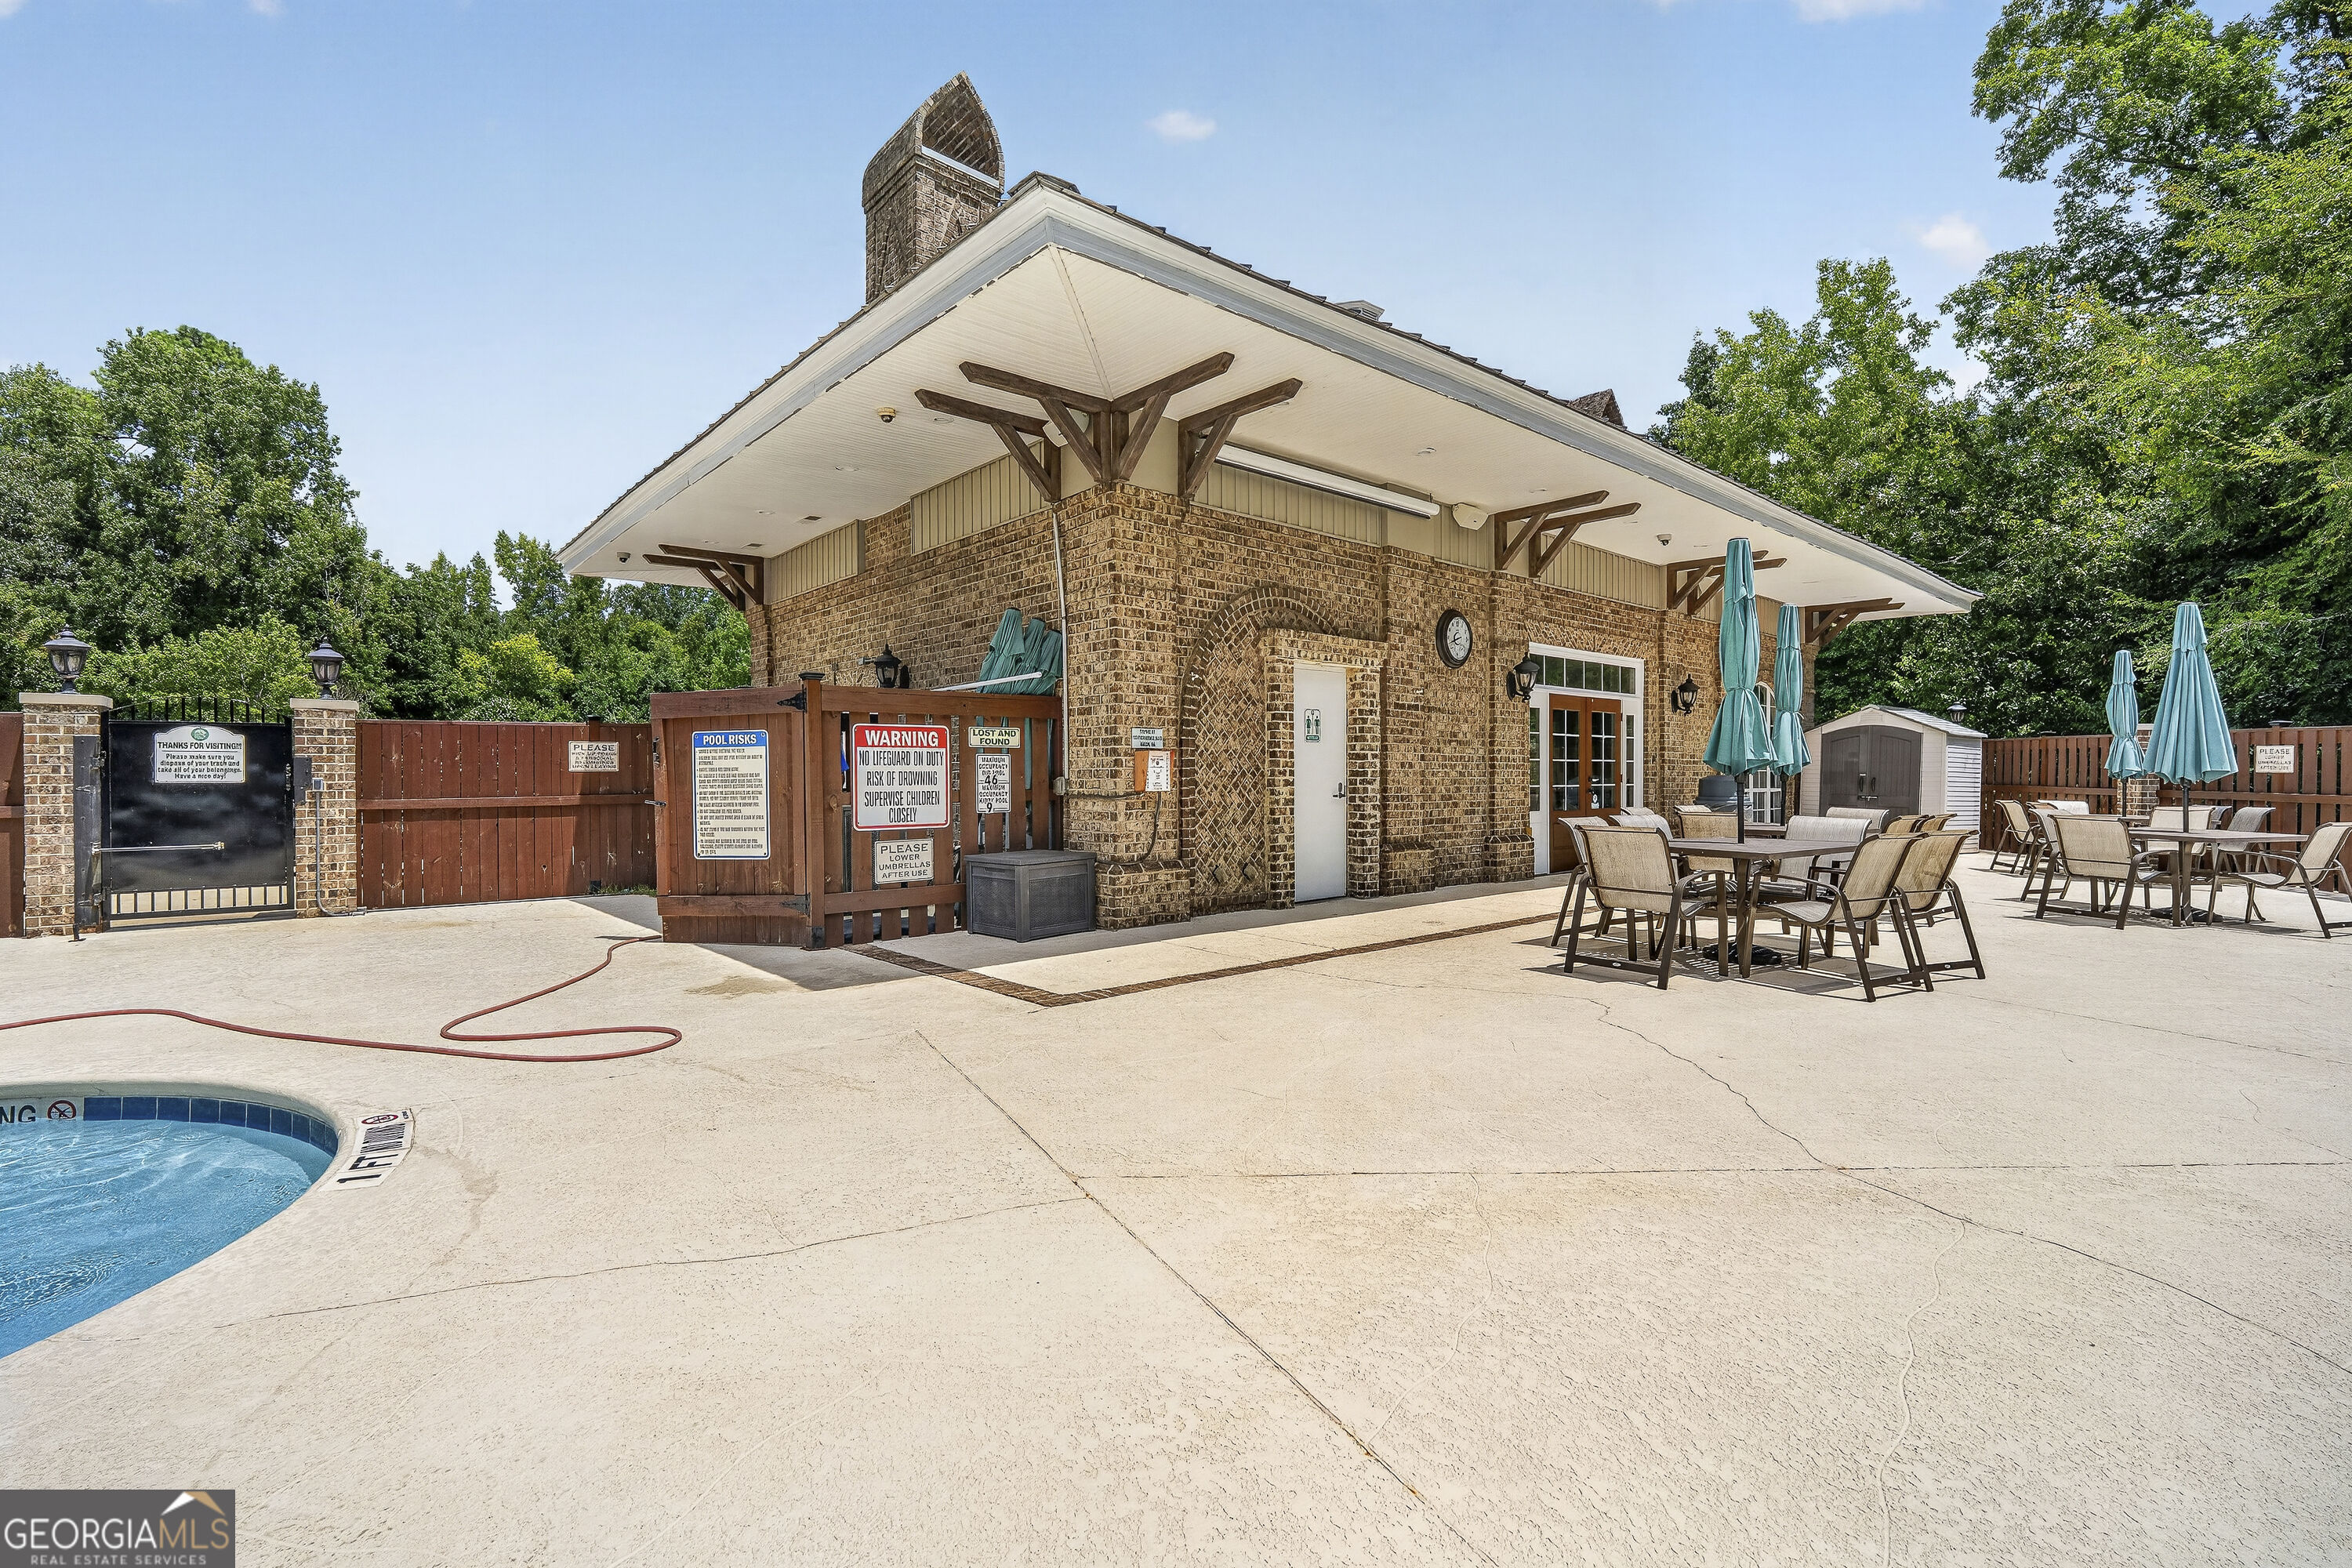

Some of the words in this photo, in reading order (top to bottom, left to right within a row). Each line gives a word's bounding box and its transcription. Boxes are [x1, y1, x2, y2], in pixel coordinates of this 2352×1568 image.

[703, 735, 728, 746] POOL
[728, 734, 757, 745] RISKS
[865, 730, 939, 747] WARNING
[859, 752, 869, 766] NO
[873, 751, 911, 766] LIFEGUARD
[913, 750, 924, 766] ON
[926, 751, 945, 766] DUTY
[866, 772, 884, 787] RISK
[887, 771, 897, 786] OF
[898, 771, 938, 786] DROWNING
[984, 774, 998, 786] 46
[864, 791, 905, 807] SUPERVISE
[906, 790, 940, 806] CHILDREN
[986, 802, 993, 813] 9
[888, 807, 917, 823] CLOSELY
[880, 843, 928, 854] PLEASE
[879, 861, 931, 871] UMBRELLAS
